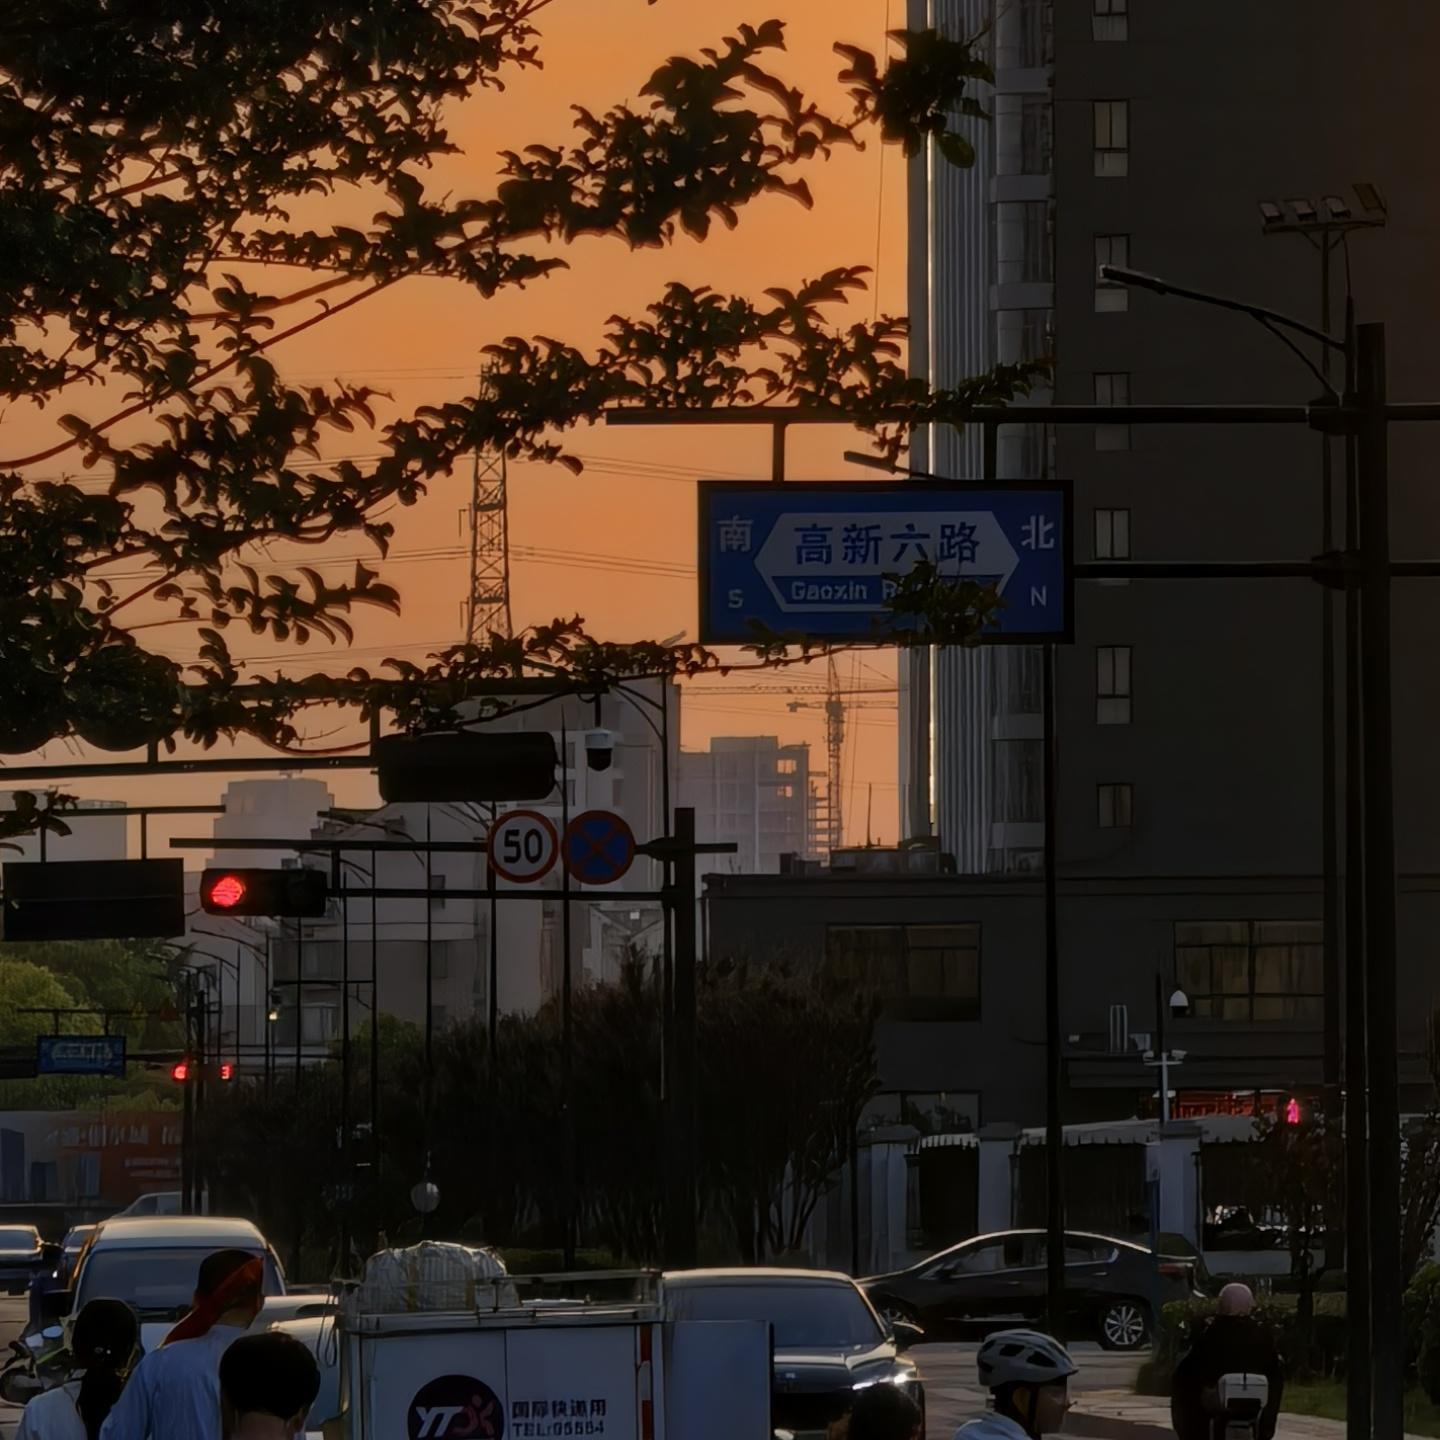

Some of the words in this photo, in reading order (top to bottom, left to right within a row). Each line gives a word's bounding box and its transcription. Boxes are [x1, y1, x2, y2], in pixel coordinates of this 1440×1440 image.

[717, 513, 753, 553] 南
[794, 522, 980, 566] 高新六路
[1021, 513, 1055, 552] 北
[727, 588, 744, 610] S
[791, 580, 868, 602] Gaoxin
[1031, 587, 1048, 608] N
[503, 828, 543, 864] 50
